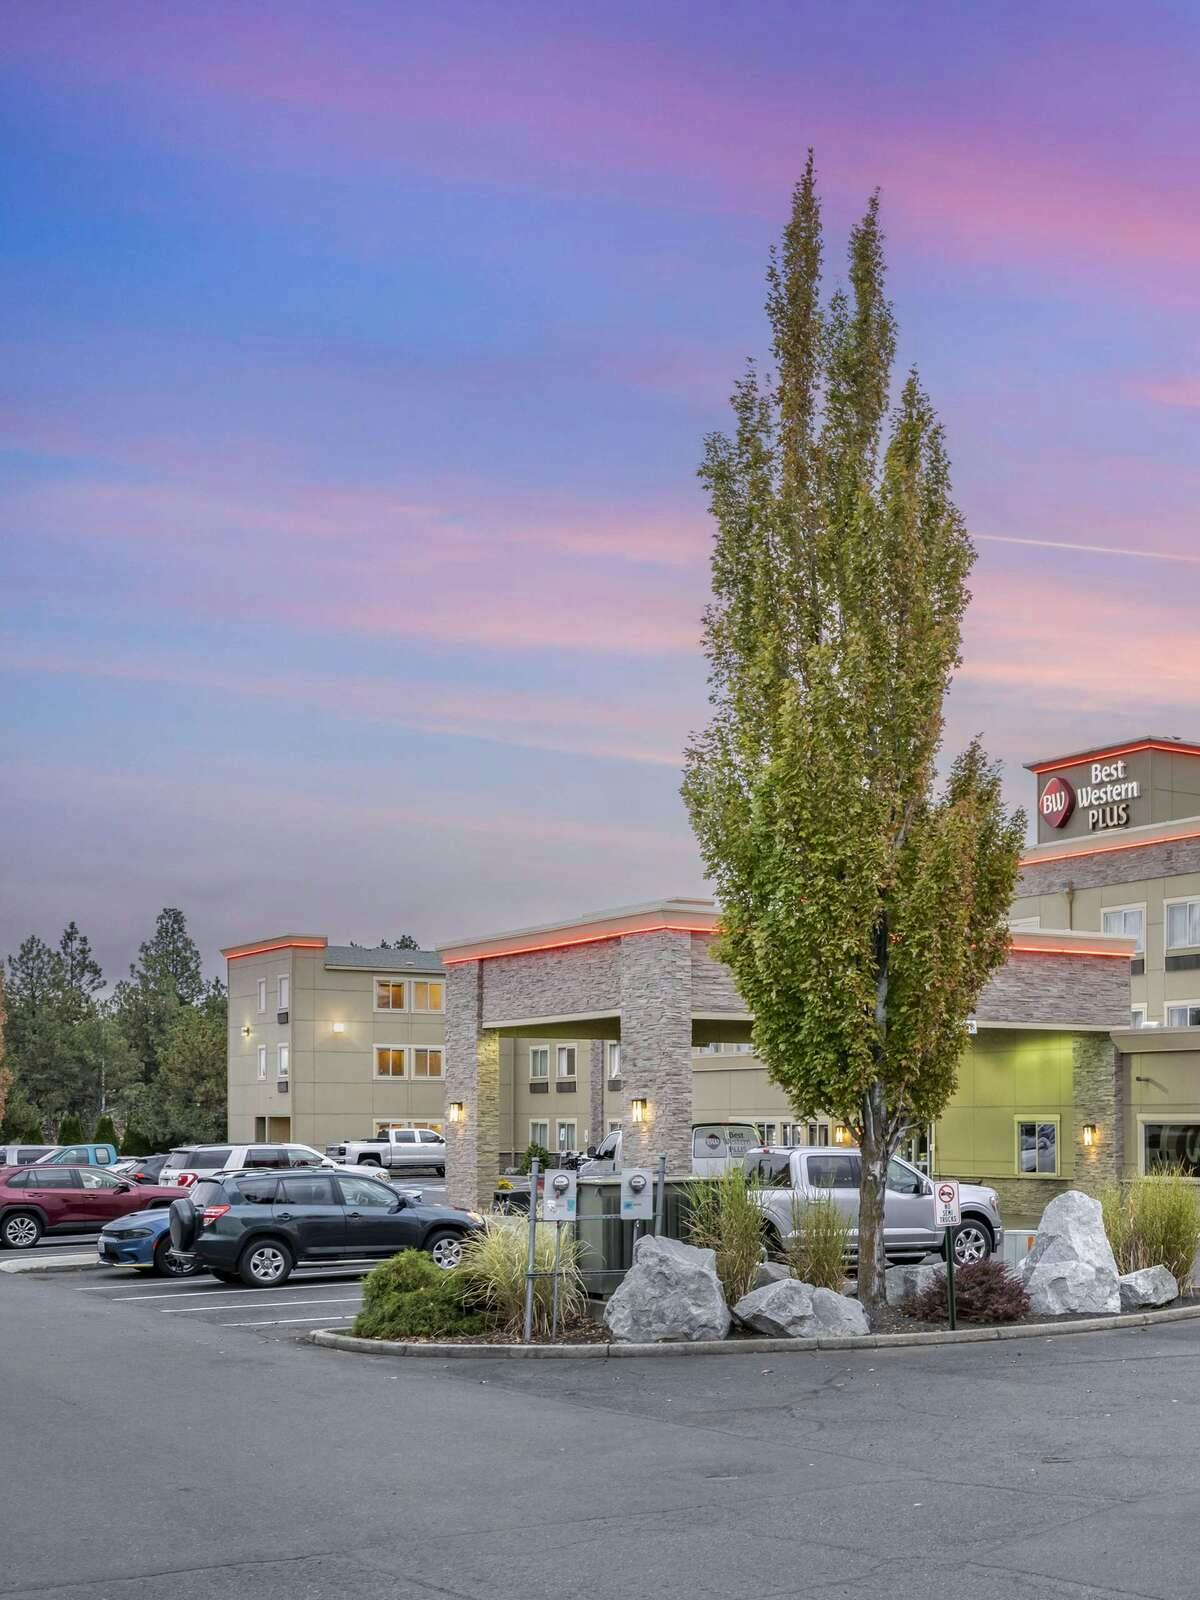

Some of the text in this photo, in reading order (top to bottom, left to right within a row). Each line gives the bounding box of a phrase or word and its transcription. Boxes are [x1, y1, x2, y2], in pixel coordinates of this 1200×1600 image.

[1091, 760, 1126, 784] Best
[1043, 791, 1065, 815] BW
[1077, 781, 1138, 808] Western
[1088, 804, 1127, 830] PLUS
[939, 1215, 957, 1223] TRUCKS
